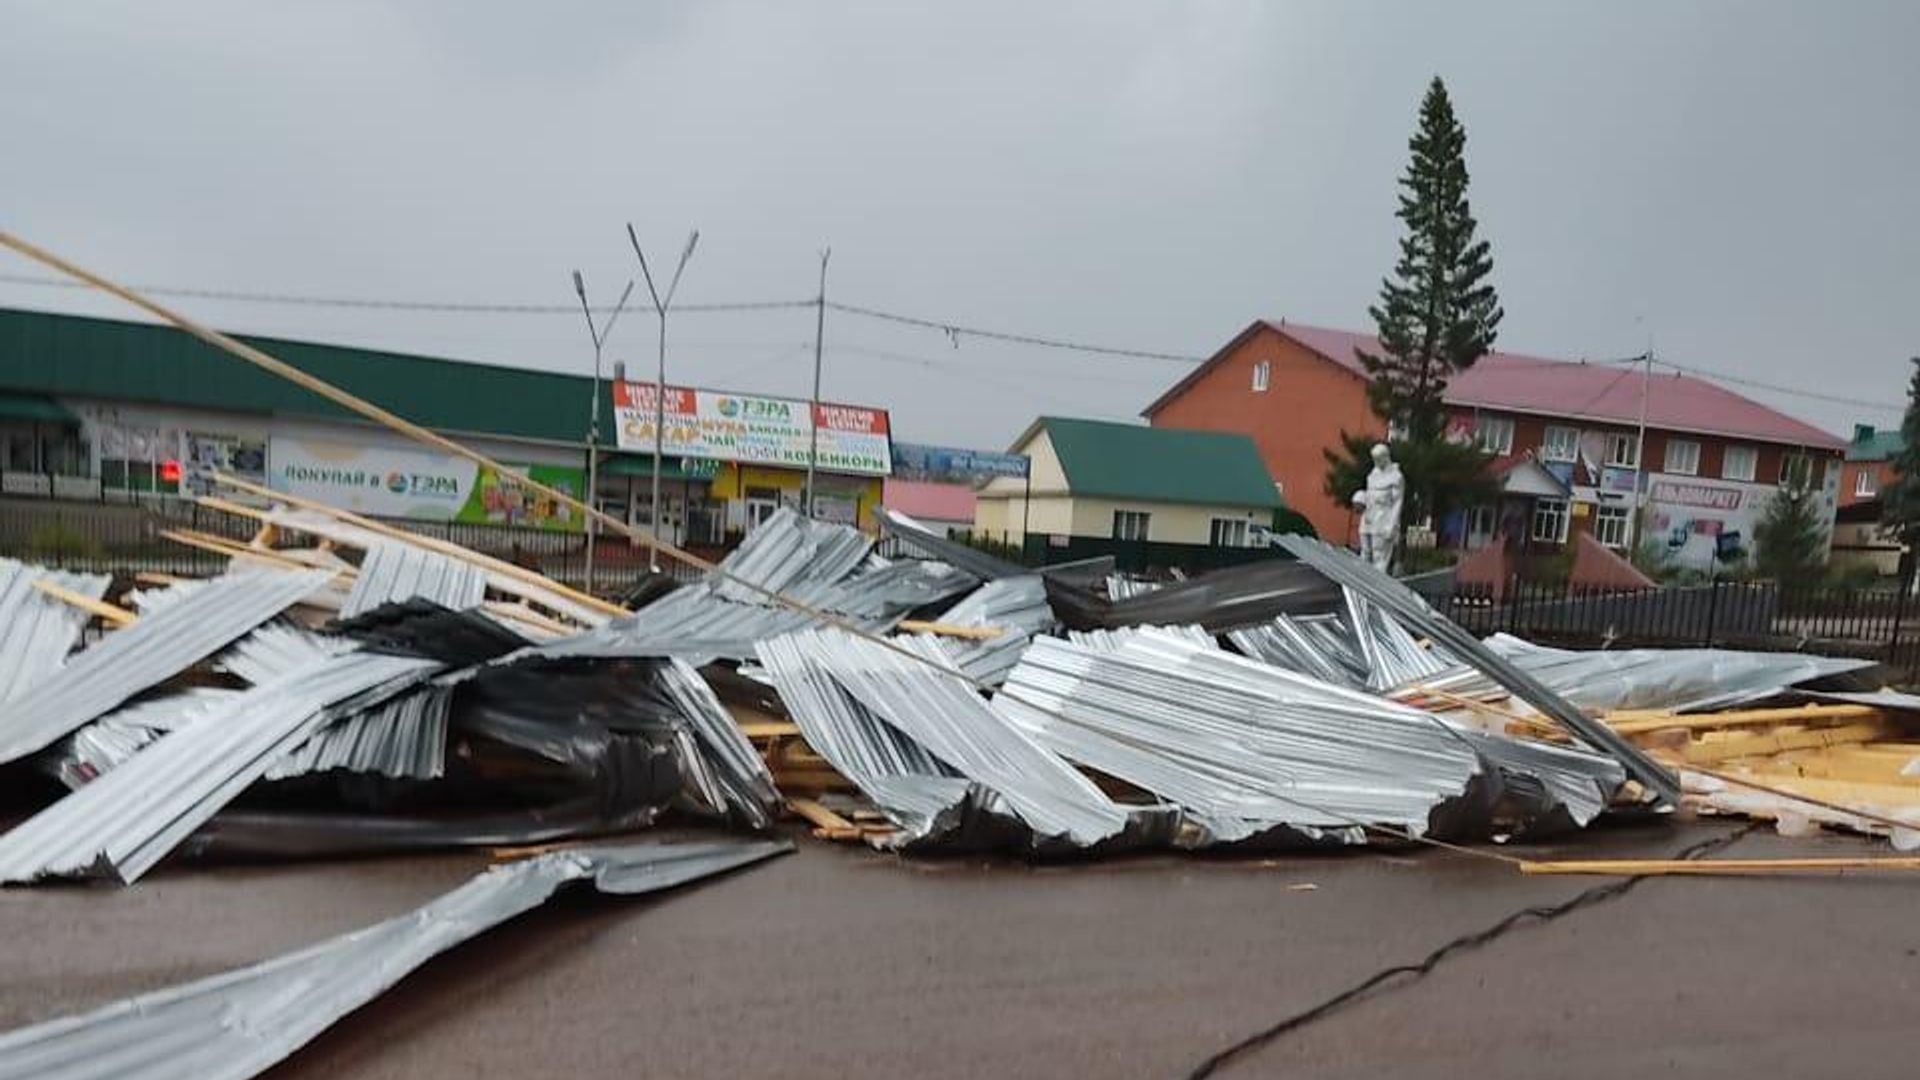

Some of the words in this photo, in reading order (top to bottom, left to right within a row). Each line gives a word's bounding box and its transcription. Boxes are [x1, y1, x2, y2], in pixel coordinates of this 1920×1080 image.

[743, 400, 790, 416] ТЭРА
[286, 464, 365, 487] ПОКУПАЙ
[410, 474, 458, 493] ТЭРА
